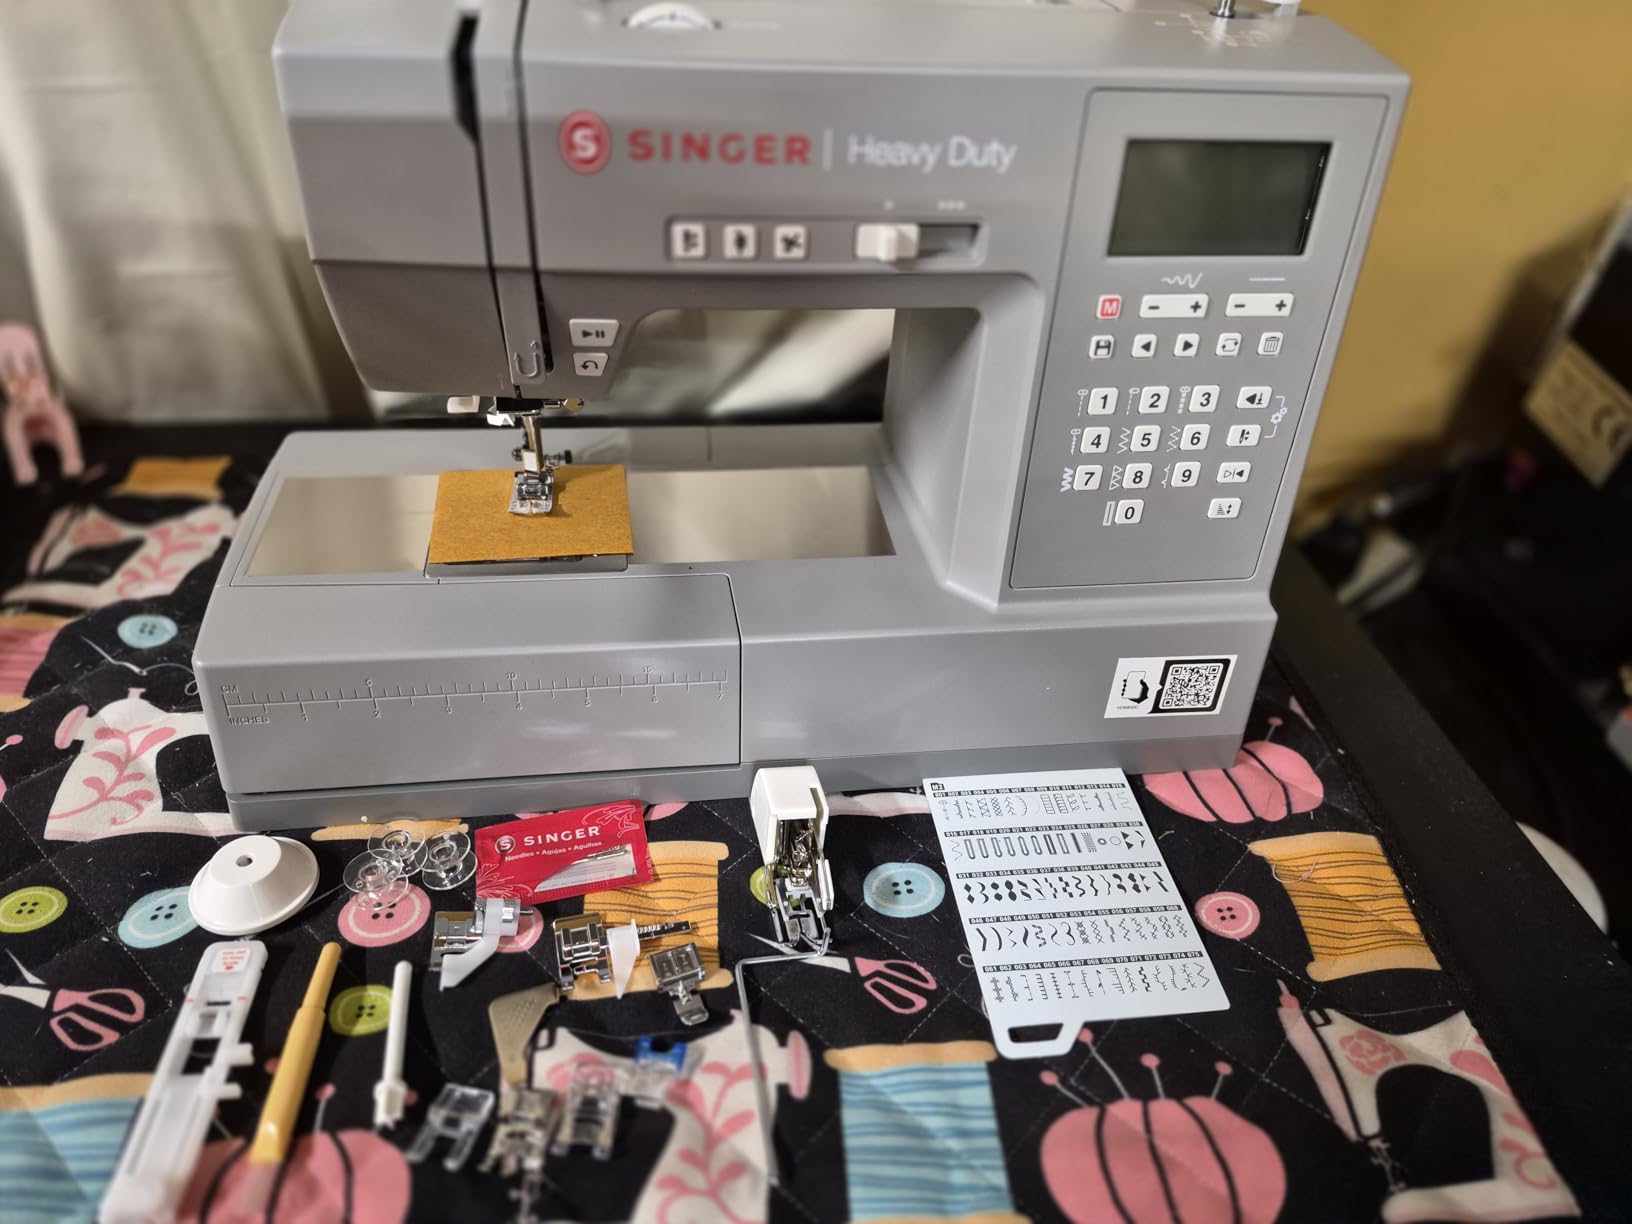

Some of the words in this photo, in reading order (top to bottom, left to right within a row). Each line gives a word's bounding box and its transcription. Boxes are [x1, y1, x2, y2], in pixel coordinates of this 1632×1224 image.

[628, 129, 812, 165] SINGER
[847, 135, 942, 173] Heavy
[947, 136, 1017, 174] Duty
[1102, 302, 1118, 316] M
[1100, 395, 1109, 409] 1
[1149, 393, 1161, 408] 2
[1199, 392, 1211, 407] 3
[1090, 434, 1102, 448] 4
[1140, 432, 1152, 447] 5
[1190, 431, 1201, 446] 6
[1083, 472, 1095, 486] 7
[1132, 470, 1144, 484] 8
[1181, 469, 1192, 483] 9
[1124, 506, 1135, 520] 0
[506, 672, 518, 680] 10
[229, 716, 271, 725] INCHES
[931, 783, 943, 791] M2
[523, 826, 600, 846] SINGER
[504, 852, 534, 862] Needles
[542, 848, 566, 856] Agujas
[574, 842, 602, 851] Agulhas
